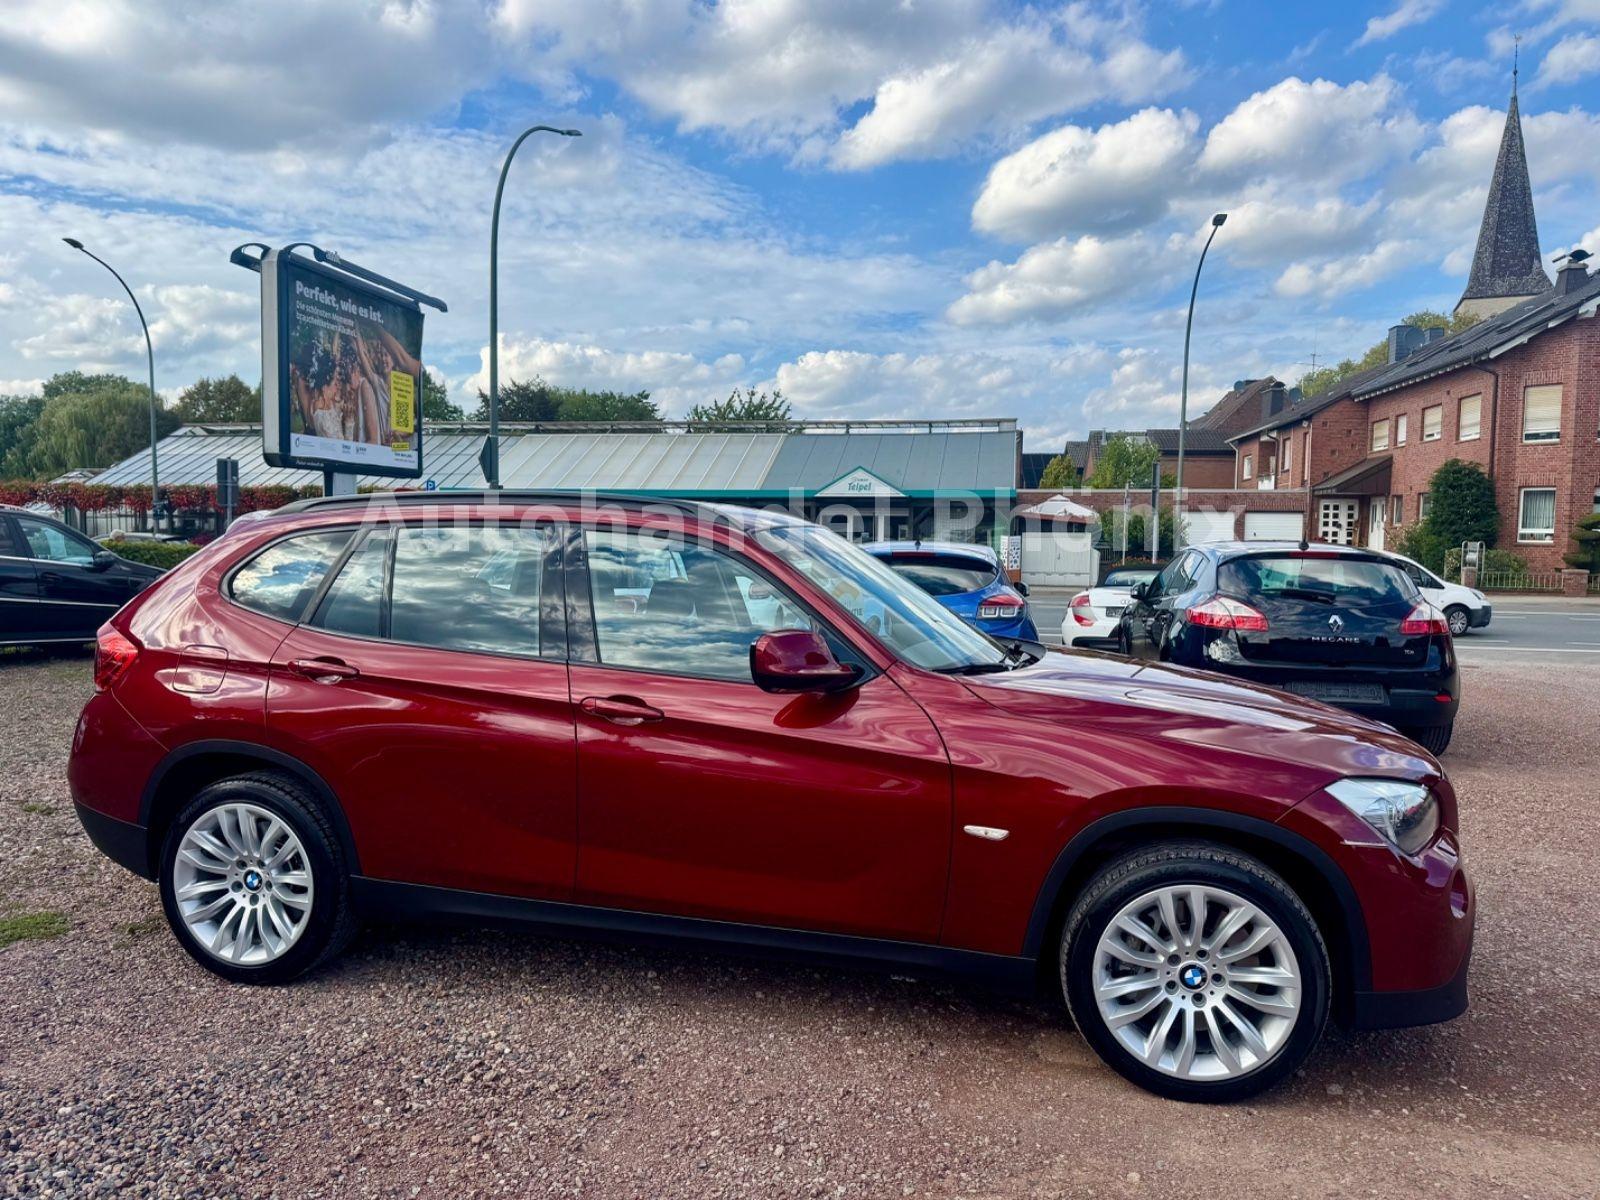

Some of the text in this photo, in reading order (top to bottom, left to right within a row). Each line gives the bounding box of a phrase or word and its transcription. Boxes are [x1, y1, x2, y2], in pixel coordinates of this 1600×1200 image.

[296, 280, 339, 311] Perfekt,
[340, 298, 358, 315] wie
[358, 306, 369, 319] es
[369, 305, 384, 325] ist.
